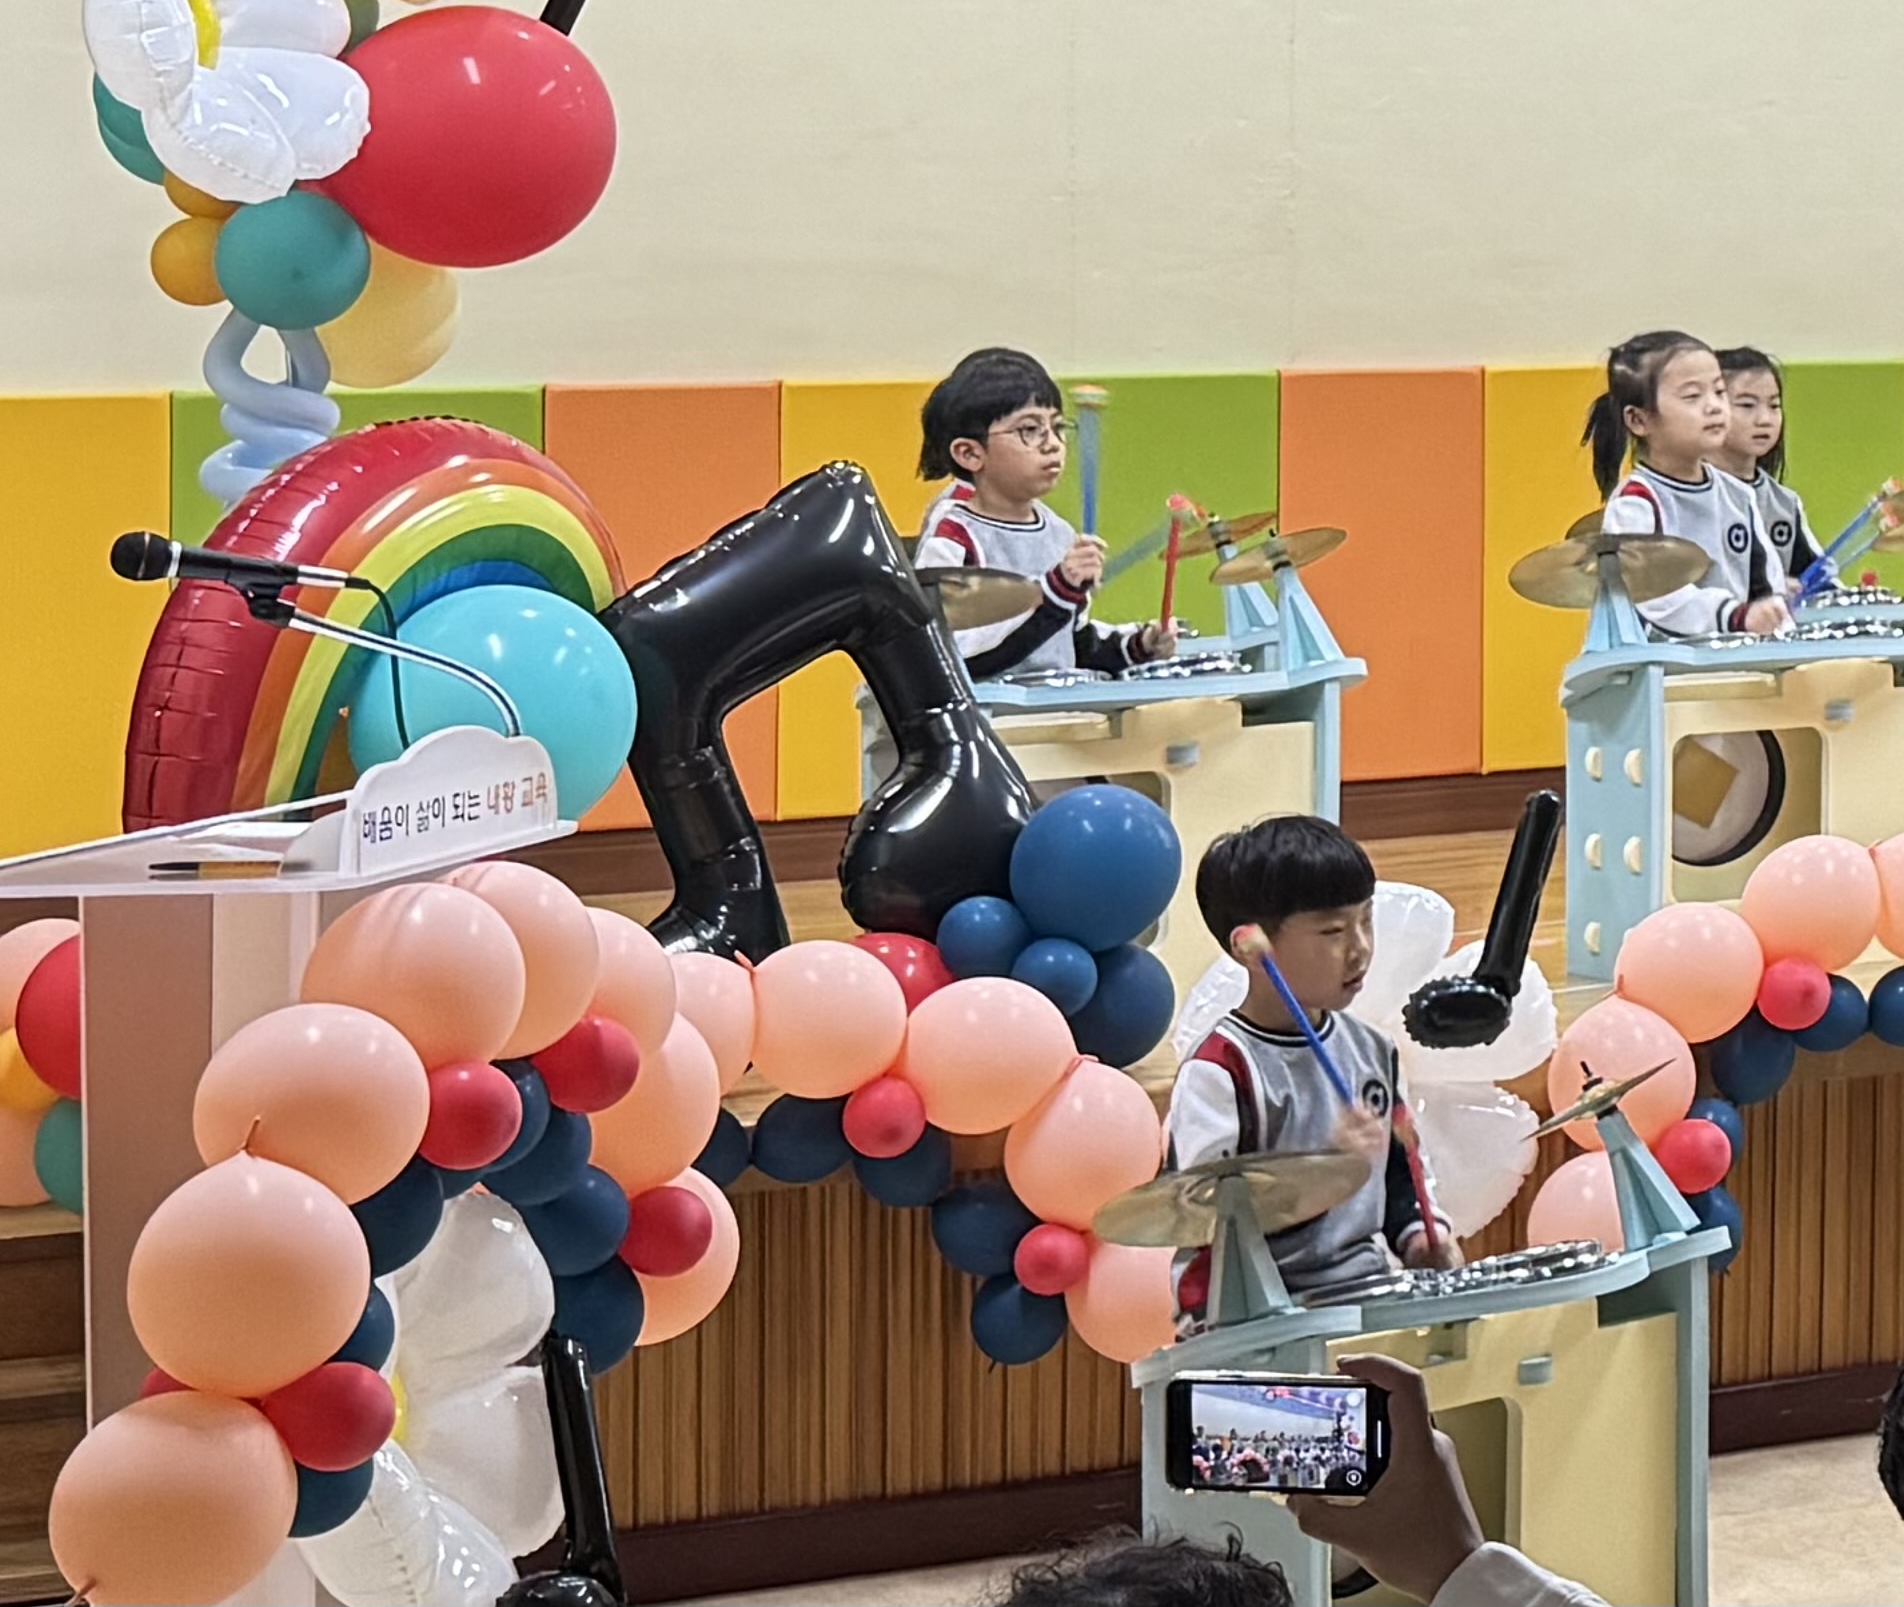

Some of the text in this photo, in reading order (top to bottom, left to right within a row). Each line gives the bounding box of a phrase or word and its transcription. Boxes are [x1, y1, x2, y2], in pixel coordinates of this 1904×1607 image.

[415, 795, 446, 834] 삶이
[451, 789, 481, 823] 되는
[486, 780, 516, 816] 내황
[520, 771, 548, 807] 교육
